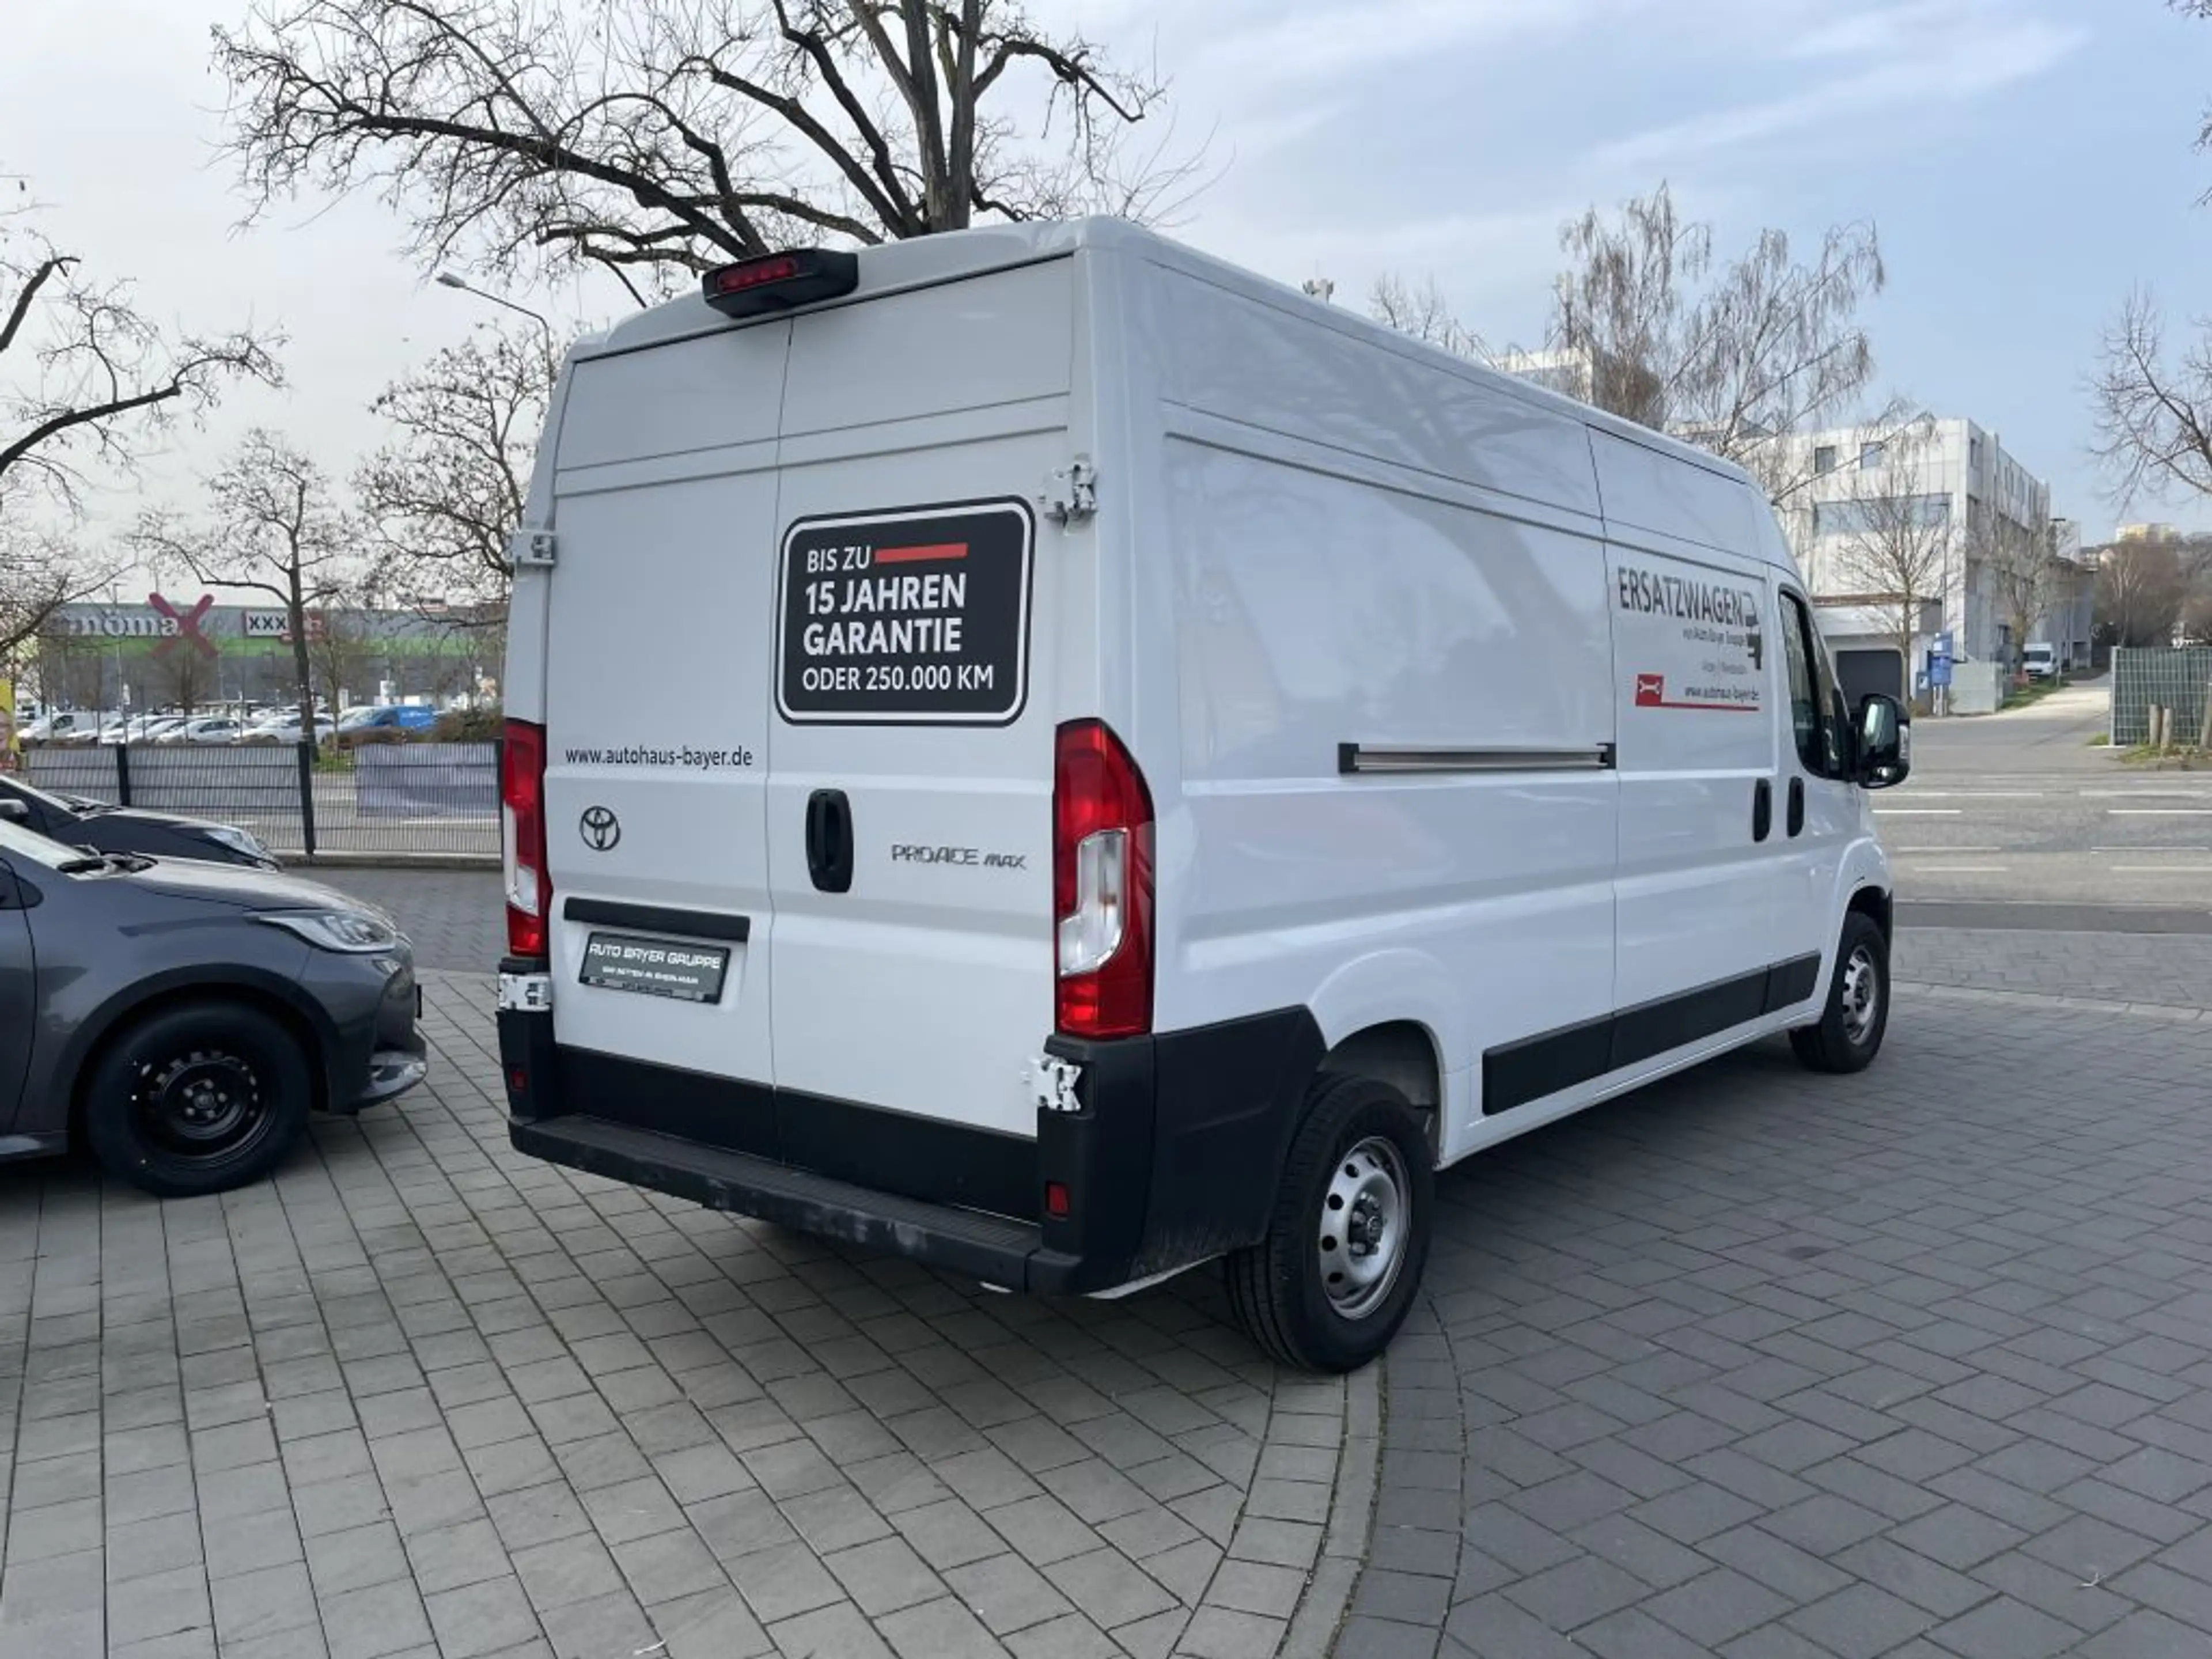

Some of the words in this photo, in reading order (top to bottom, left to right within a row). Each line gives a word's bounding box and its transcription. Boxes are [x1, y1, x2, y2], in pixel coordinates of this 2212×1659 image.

[807, 548, 838, 573] BIS
[842, 545, 872, 570] ZU
[805, 581, 835, 614] 15
[840, 573, 967, 612] JAHREN
[1618, 565, 1744, 626] ERSATZWAGEN
[803, 618, 963, 656] GARANTIE
[802, 667, 861, 690] ODER
[866, 665, 950, 690] 250.000
[957, 665, 993, 690] KM
[566, 745, 753, 770] www.autohaus-bayer.de
[892, 844, 979, 865] PROACE
[589, 943, 622, 957] AUTO
[623, 947, 664, 964] BAYER
[666, 952, 721, 969] GRUPPE
